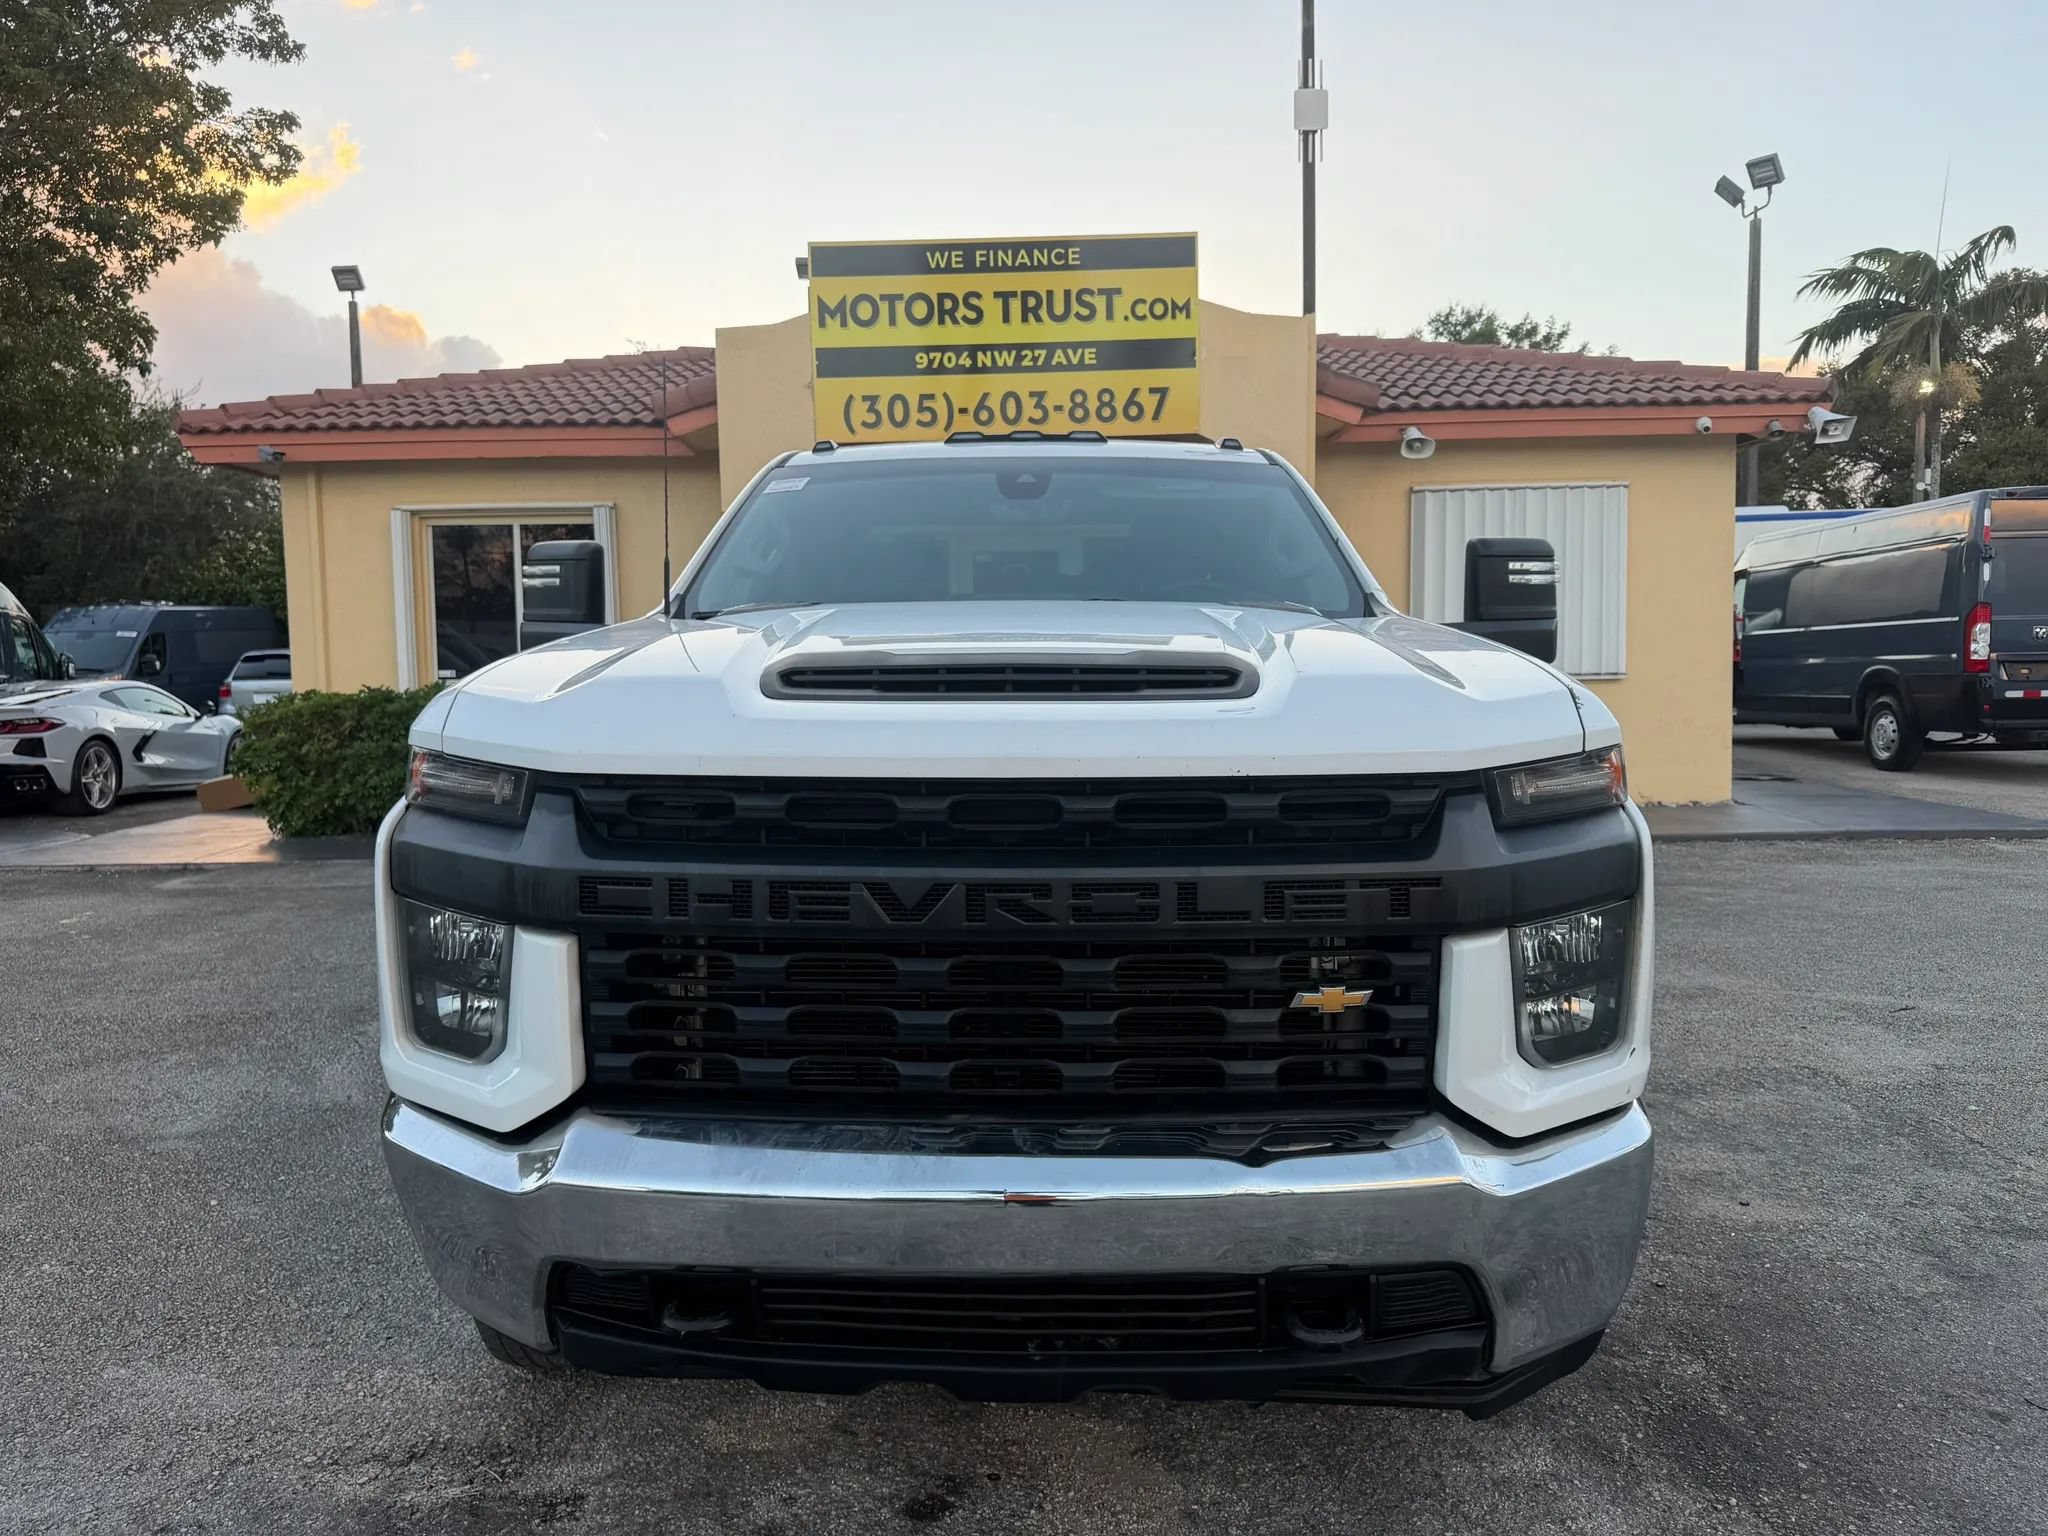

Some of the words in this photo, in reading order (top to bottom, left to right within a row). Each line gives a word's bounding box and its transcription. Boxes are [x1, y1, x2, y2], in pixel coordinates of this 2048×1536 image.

[926, 250, 964, 269] WE
[975, 247, 1081, 268] FINANCE
[816, 290, 985, 330] MOTORS
[914, 351, 972, 370] 9704
[976, 350, 1016, 368] NW
[1020, 349, 1048, 367] 27
[1051, 347, 1097, 366] AVE
[843, 386, 1170, 436] (305)-603-8867
[577, 875, 1443, 926] CHEVROLET
